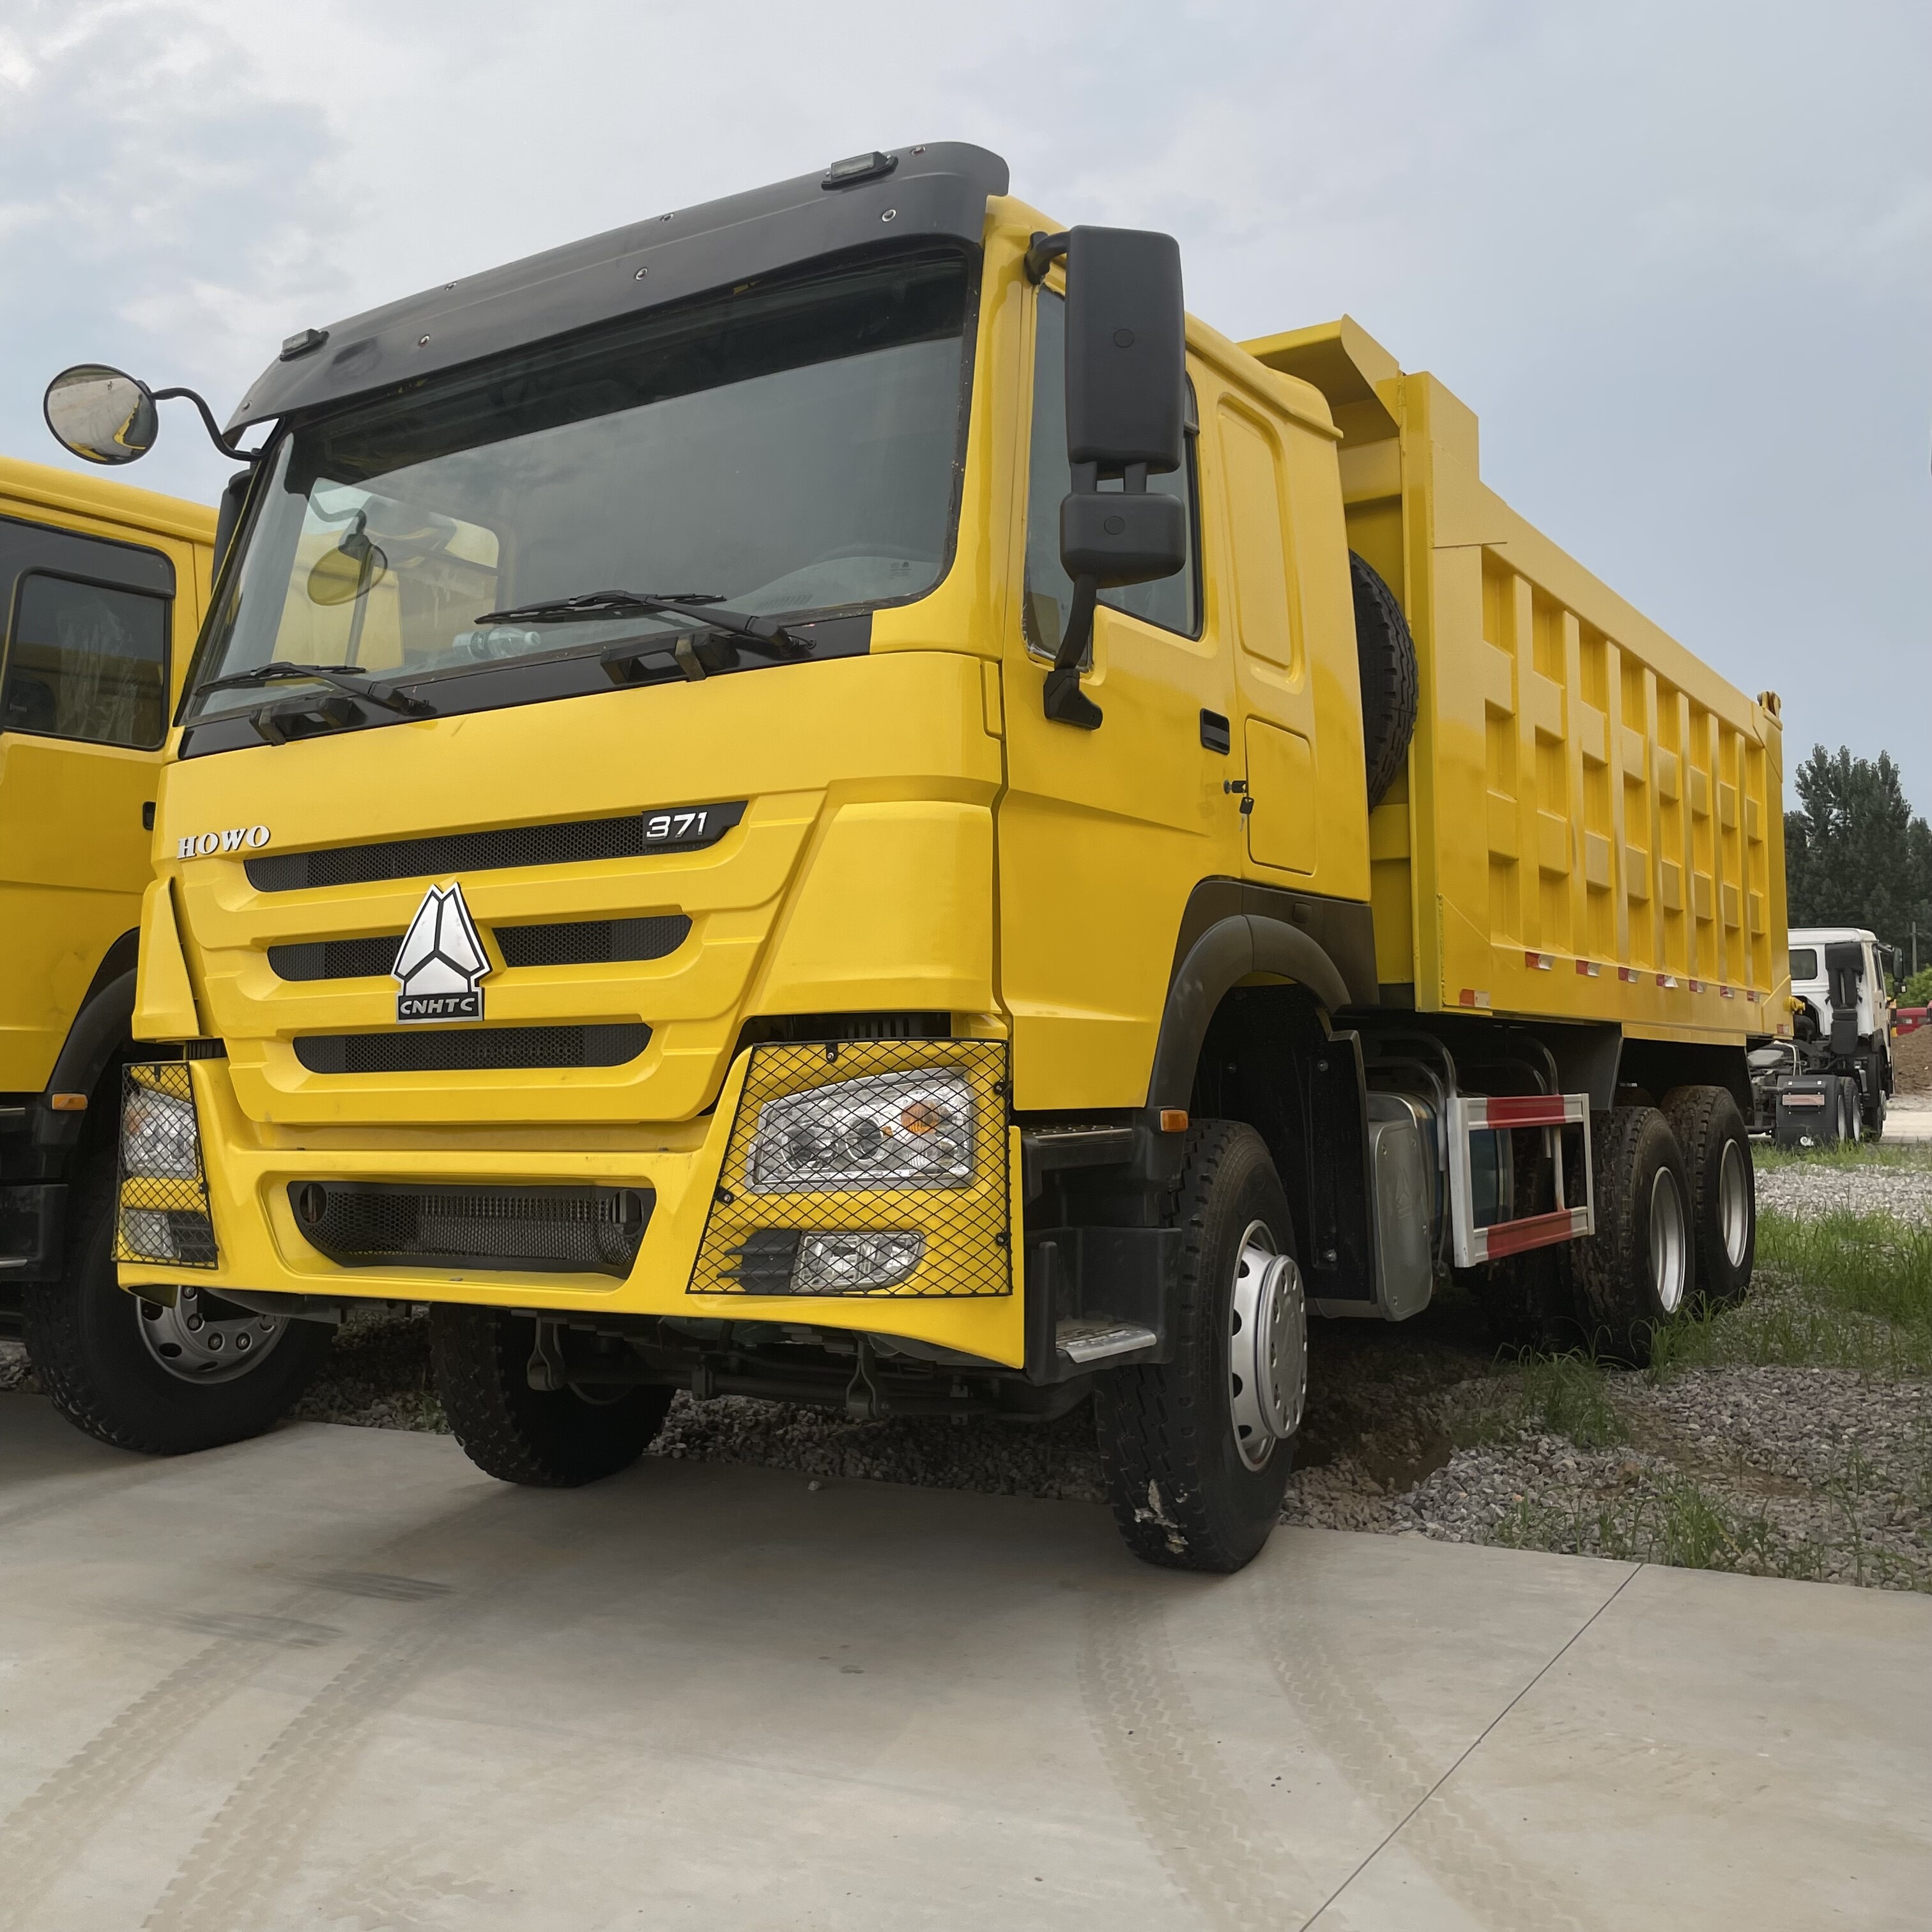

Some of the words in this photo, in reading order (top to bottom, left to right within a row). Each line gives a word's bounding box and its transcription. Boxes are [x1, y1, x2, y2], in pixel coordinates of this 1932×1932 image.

[647, 811, 707, 840] 371
[177, 825, 271, 859] HOWO
[400, 997, 475, 1015] CNHTC
